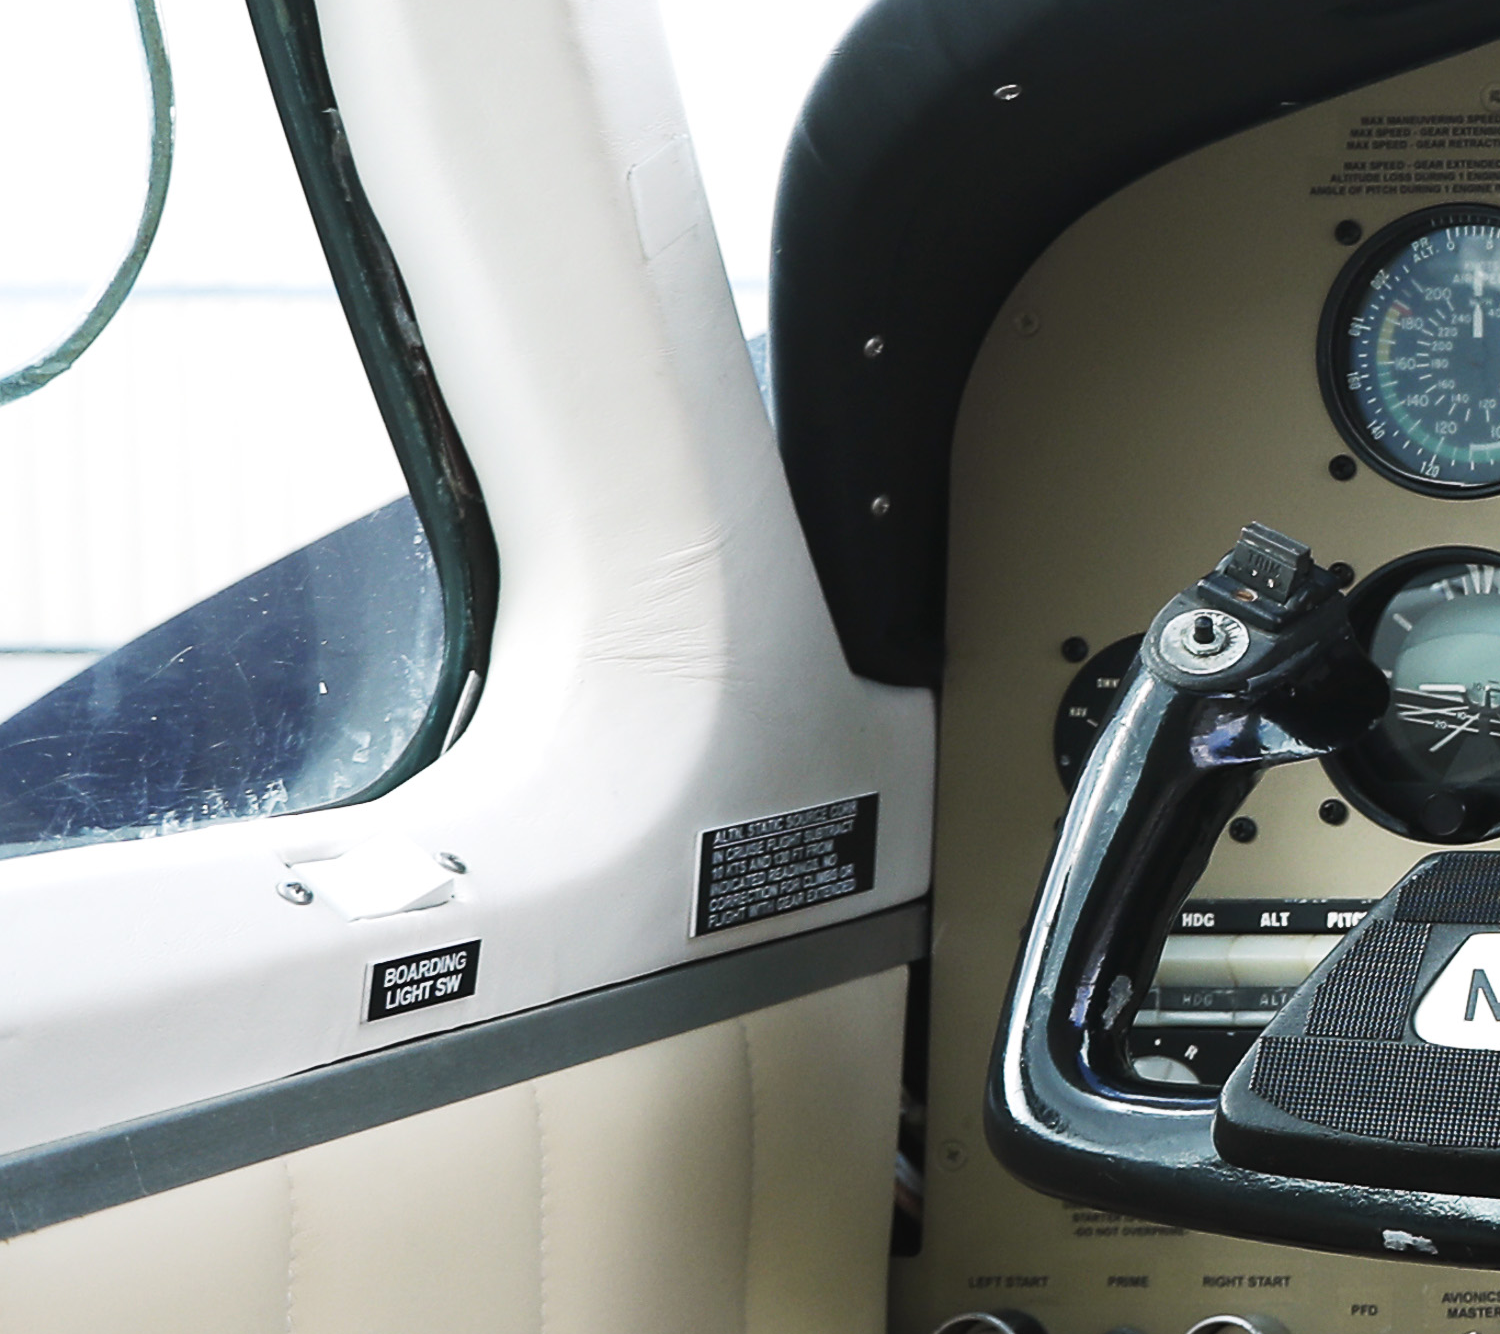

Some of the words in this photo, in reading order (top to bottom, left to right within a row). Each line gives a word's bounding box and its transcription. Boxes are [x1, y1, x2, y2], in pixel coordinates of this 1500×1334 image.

[383, 952, 468, 988] BOARDING
[386, 982, 433, 1009] LIGHT
[435, 974, 461, 997] SW
